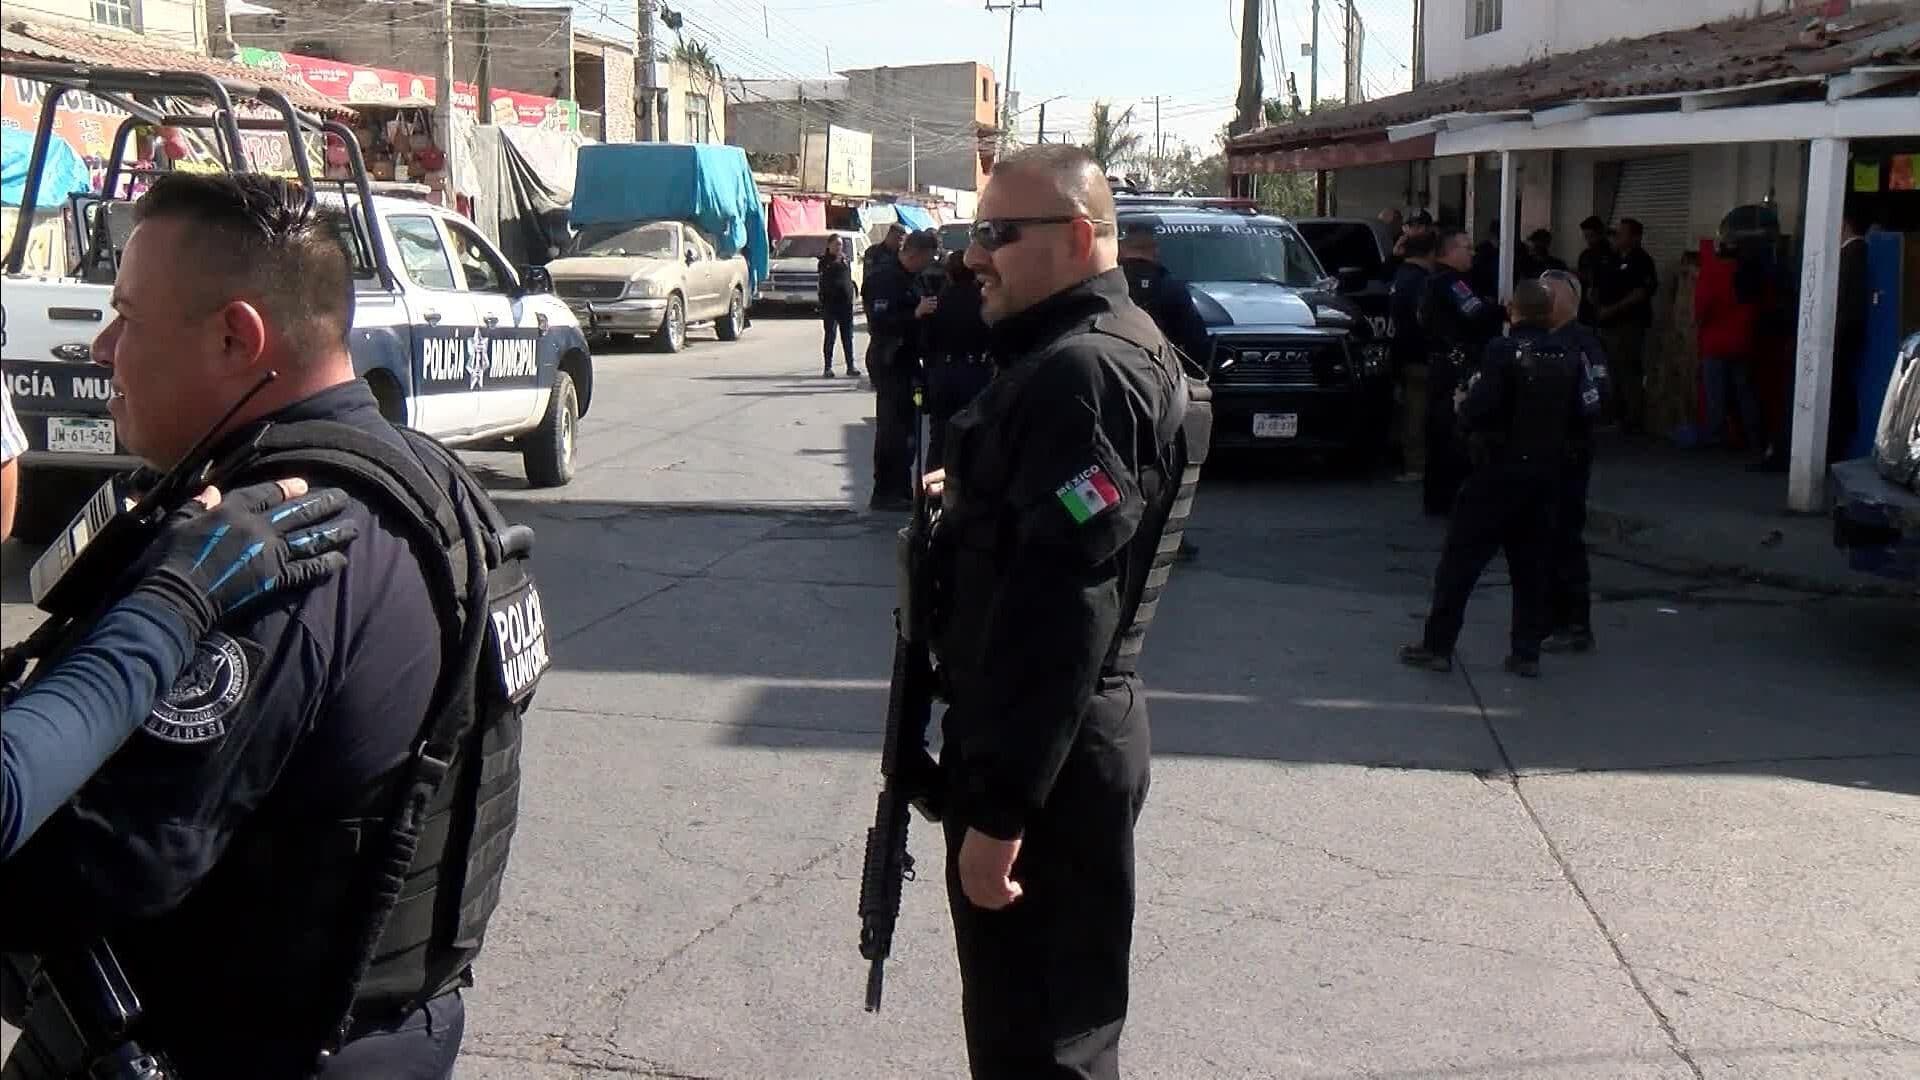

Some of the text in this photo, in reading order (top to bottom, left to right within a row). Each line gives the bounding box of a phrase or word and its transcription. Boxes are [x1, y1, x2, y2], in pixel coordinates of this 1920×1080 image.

[422, 328, 538, 381] POLICÍA MUNICIPAL
[7, 369, 56, 397] ICÍA
